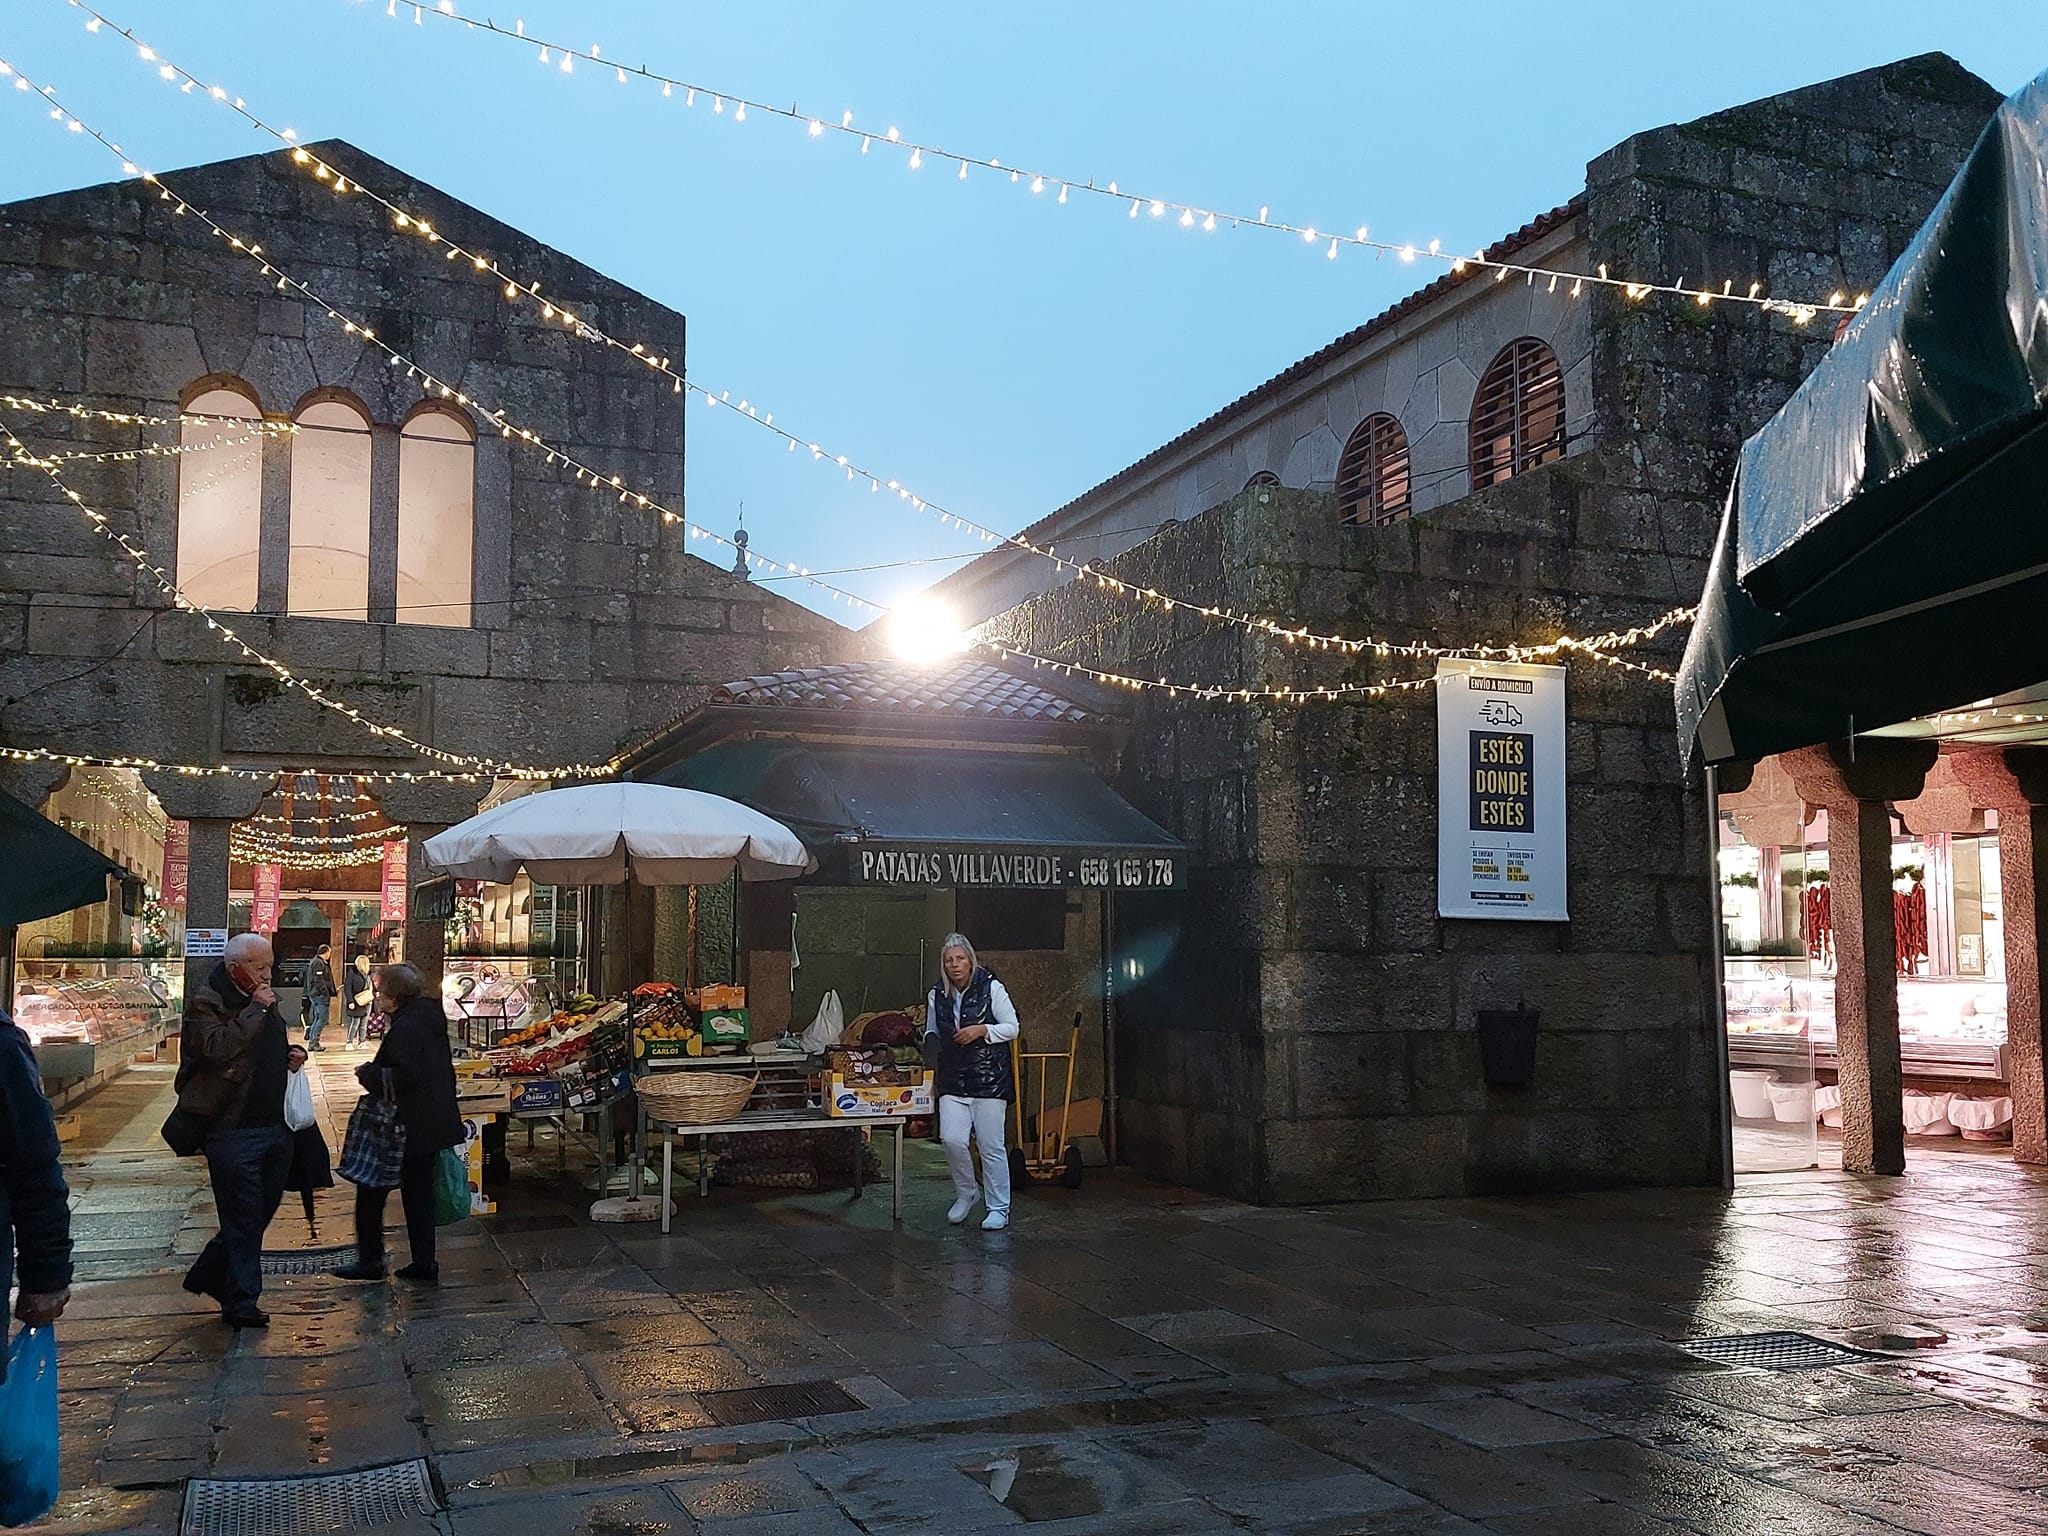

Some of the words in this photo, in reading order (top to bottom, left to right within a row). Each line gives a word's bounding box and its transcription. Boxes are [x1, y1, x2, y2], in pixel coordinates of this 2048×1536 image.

[1470, 678, 1490, 690] ENVÍO
[1491, 680, 1497, 691] A
[1497, 680, 1532, 693] DOMICILIO
[1479, 735, 1524, 765] ESTÉS
[1476, 769, 1528, 796] DONDE
[1480, 797, 1525, 826] ESTÉS
[862, 850, 942, 883] PATATAS
[948, 854, 1062, 885] VILLAVERDE
[1080, 858, 1109, 886] 658
[1113, 858, 1142, 887] 165
[1146, 858, 1173, 887] 178
[651, 1047, 679, 1055] CARLOS
[870, 1100, 897, 1108] Coplaca
